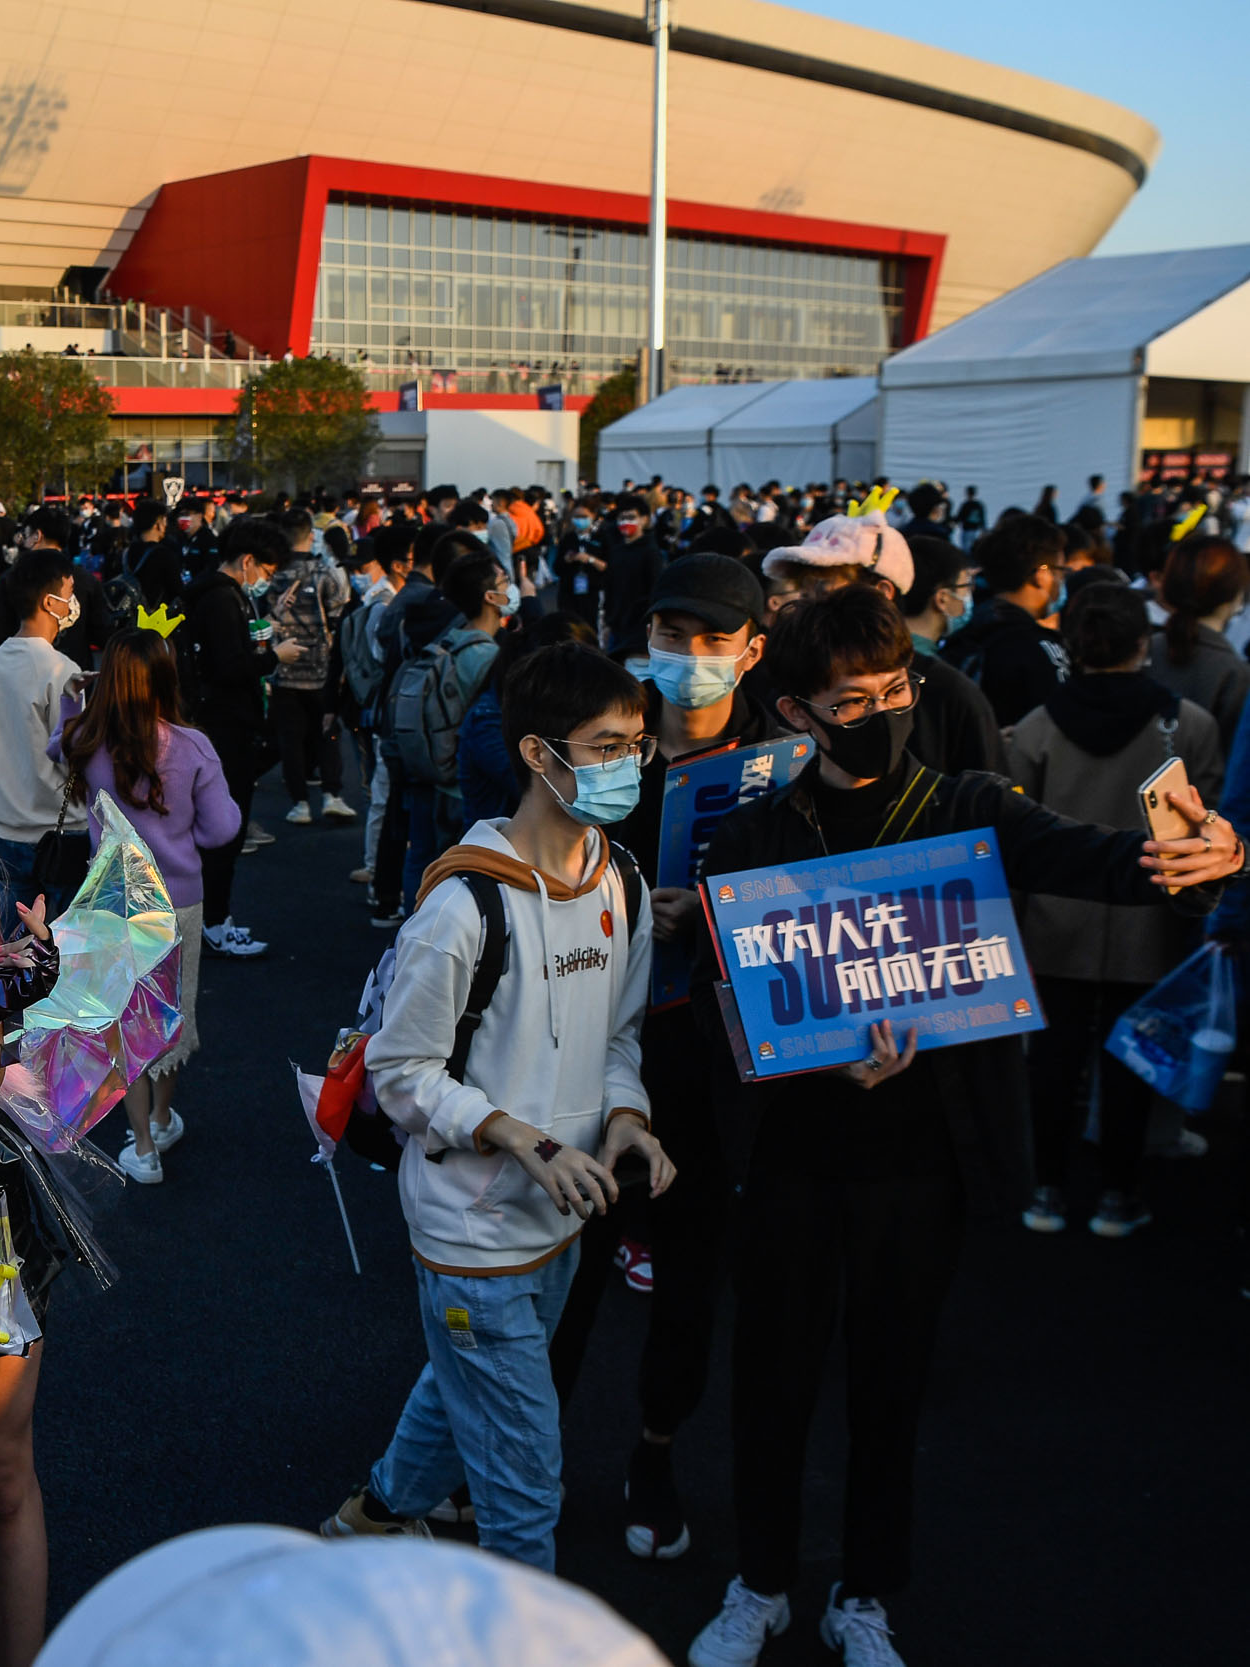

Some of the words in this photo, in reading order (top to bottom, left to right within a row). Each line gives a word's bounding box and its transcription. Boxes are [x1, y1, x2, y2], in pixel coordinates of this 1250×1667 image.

[732, 902, 913, 968] 敢为人先
[835, 935, 1016, 1004] 所向无前
